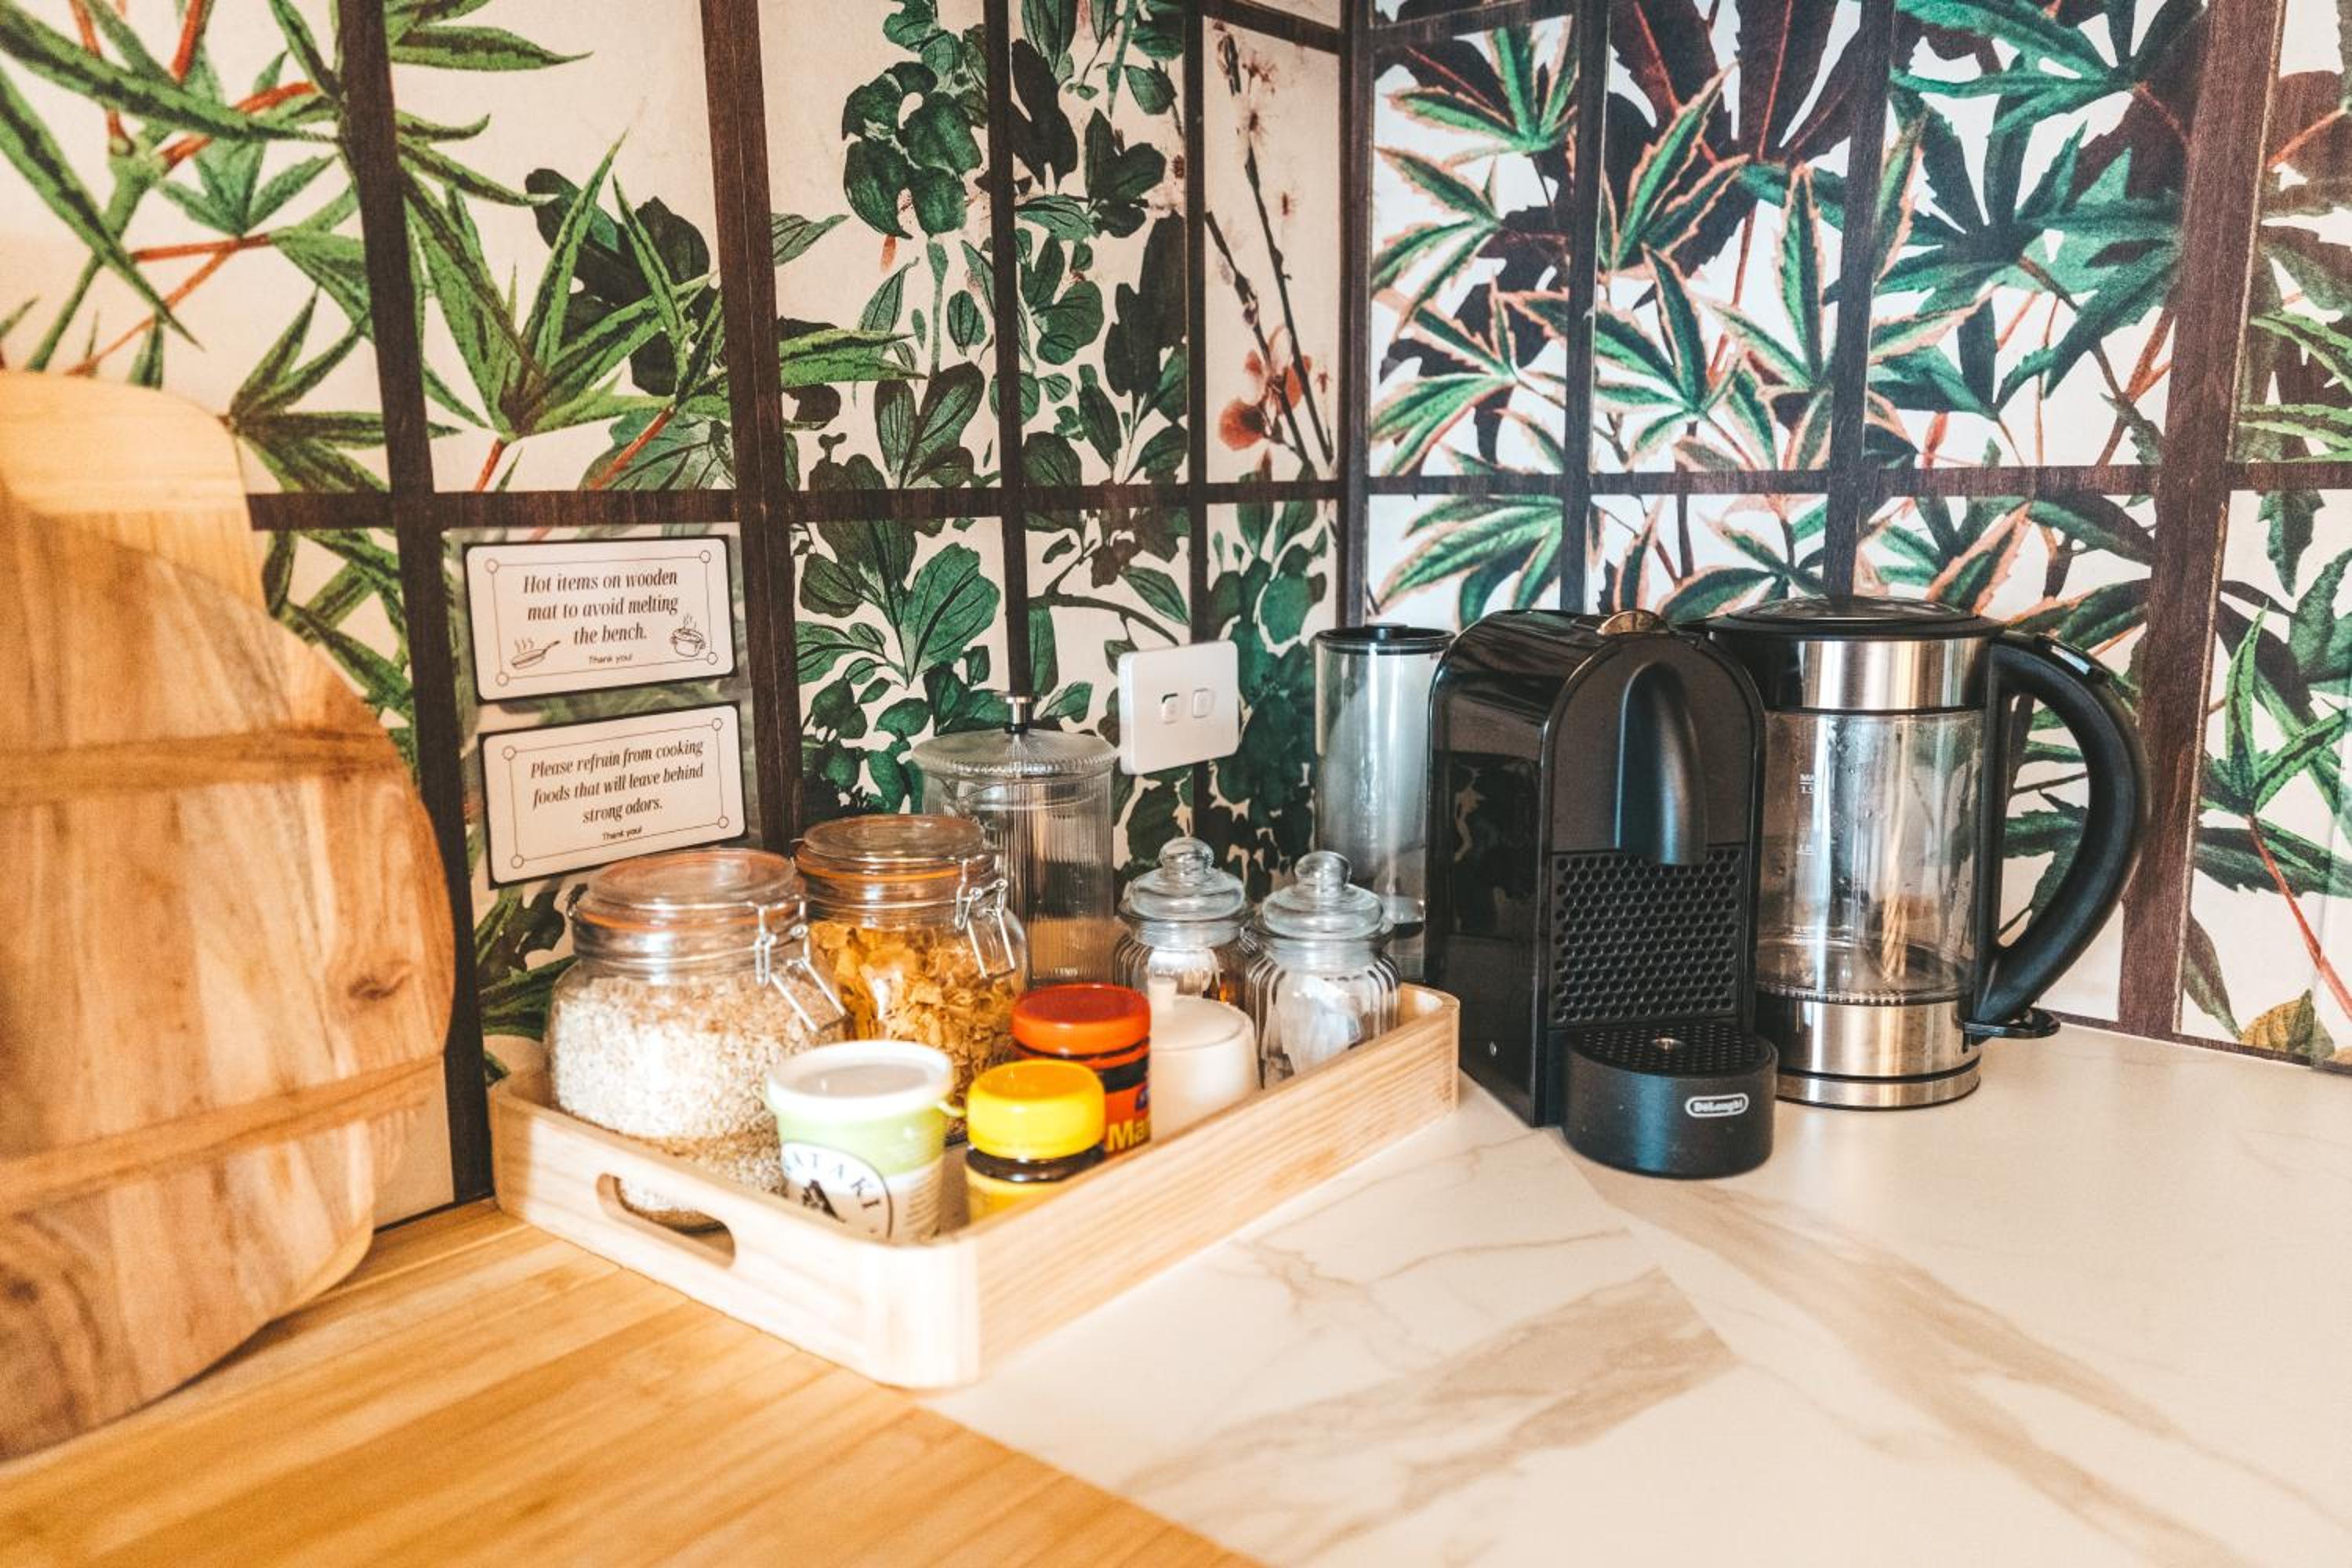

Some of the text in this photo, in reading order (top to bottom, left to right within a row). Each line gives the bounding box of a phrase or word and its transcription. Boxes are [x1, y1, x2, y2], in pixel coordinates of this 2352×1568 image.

[523, 568, 678, 593] Hot items on wooden
[527, 594, 679, 621] mat to avoid melting
[573, 622, 648, 645] the bench.
[531, 739, 703, 779] Please refrain from cooking
[532, 764, 703, 810] foods that will leave behind
[583, 797, 662, 823] strong odors.
